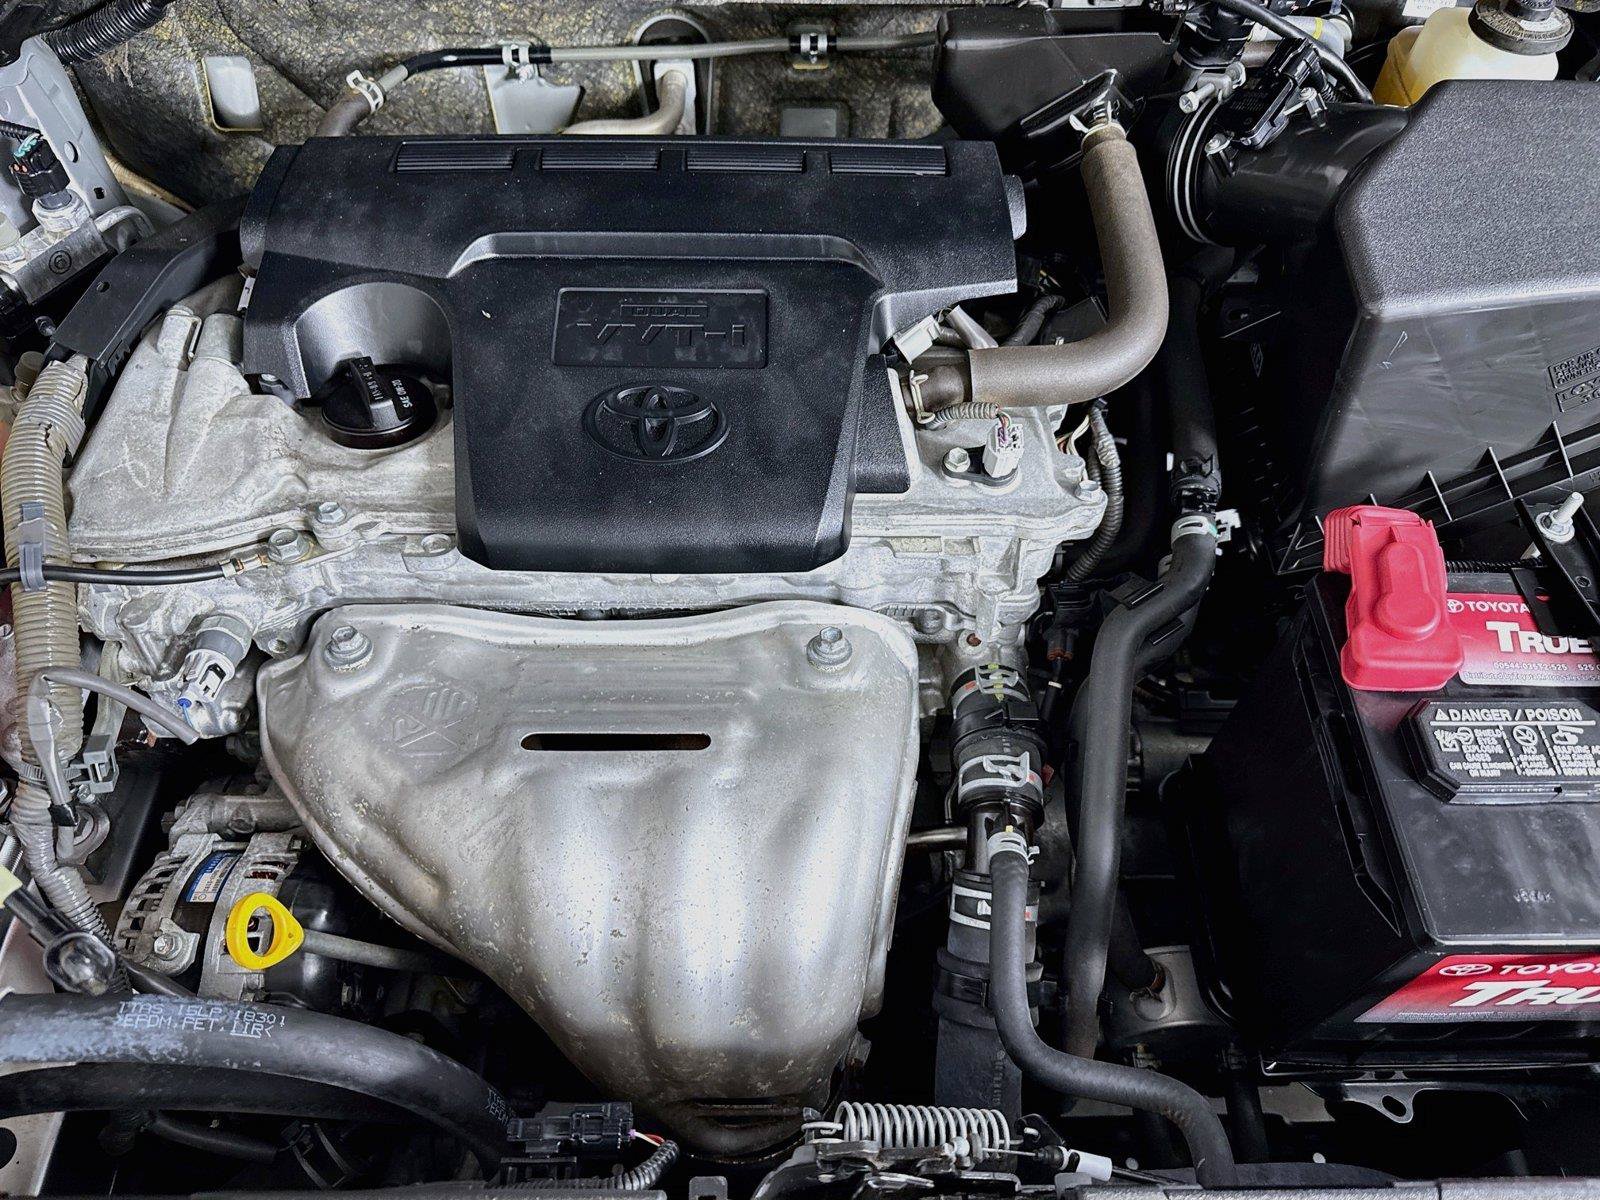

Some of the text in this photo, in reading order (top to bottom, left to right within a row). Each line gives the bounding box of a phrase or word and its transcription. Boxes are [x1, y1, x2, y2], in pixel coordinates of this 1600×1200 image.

[1465, 600, 1530, 613] TOYOTA
[1448, 708, 1512, 721] DANGER
[1524, 708, 1583, 721] POISON
[1522, 745, 1538, 755] NO
[1500, 962, 1600, 976] TOYO
